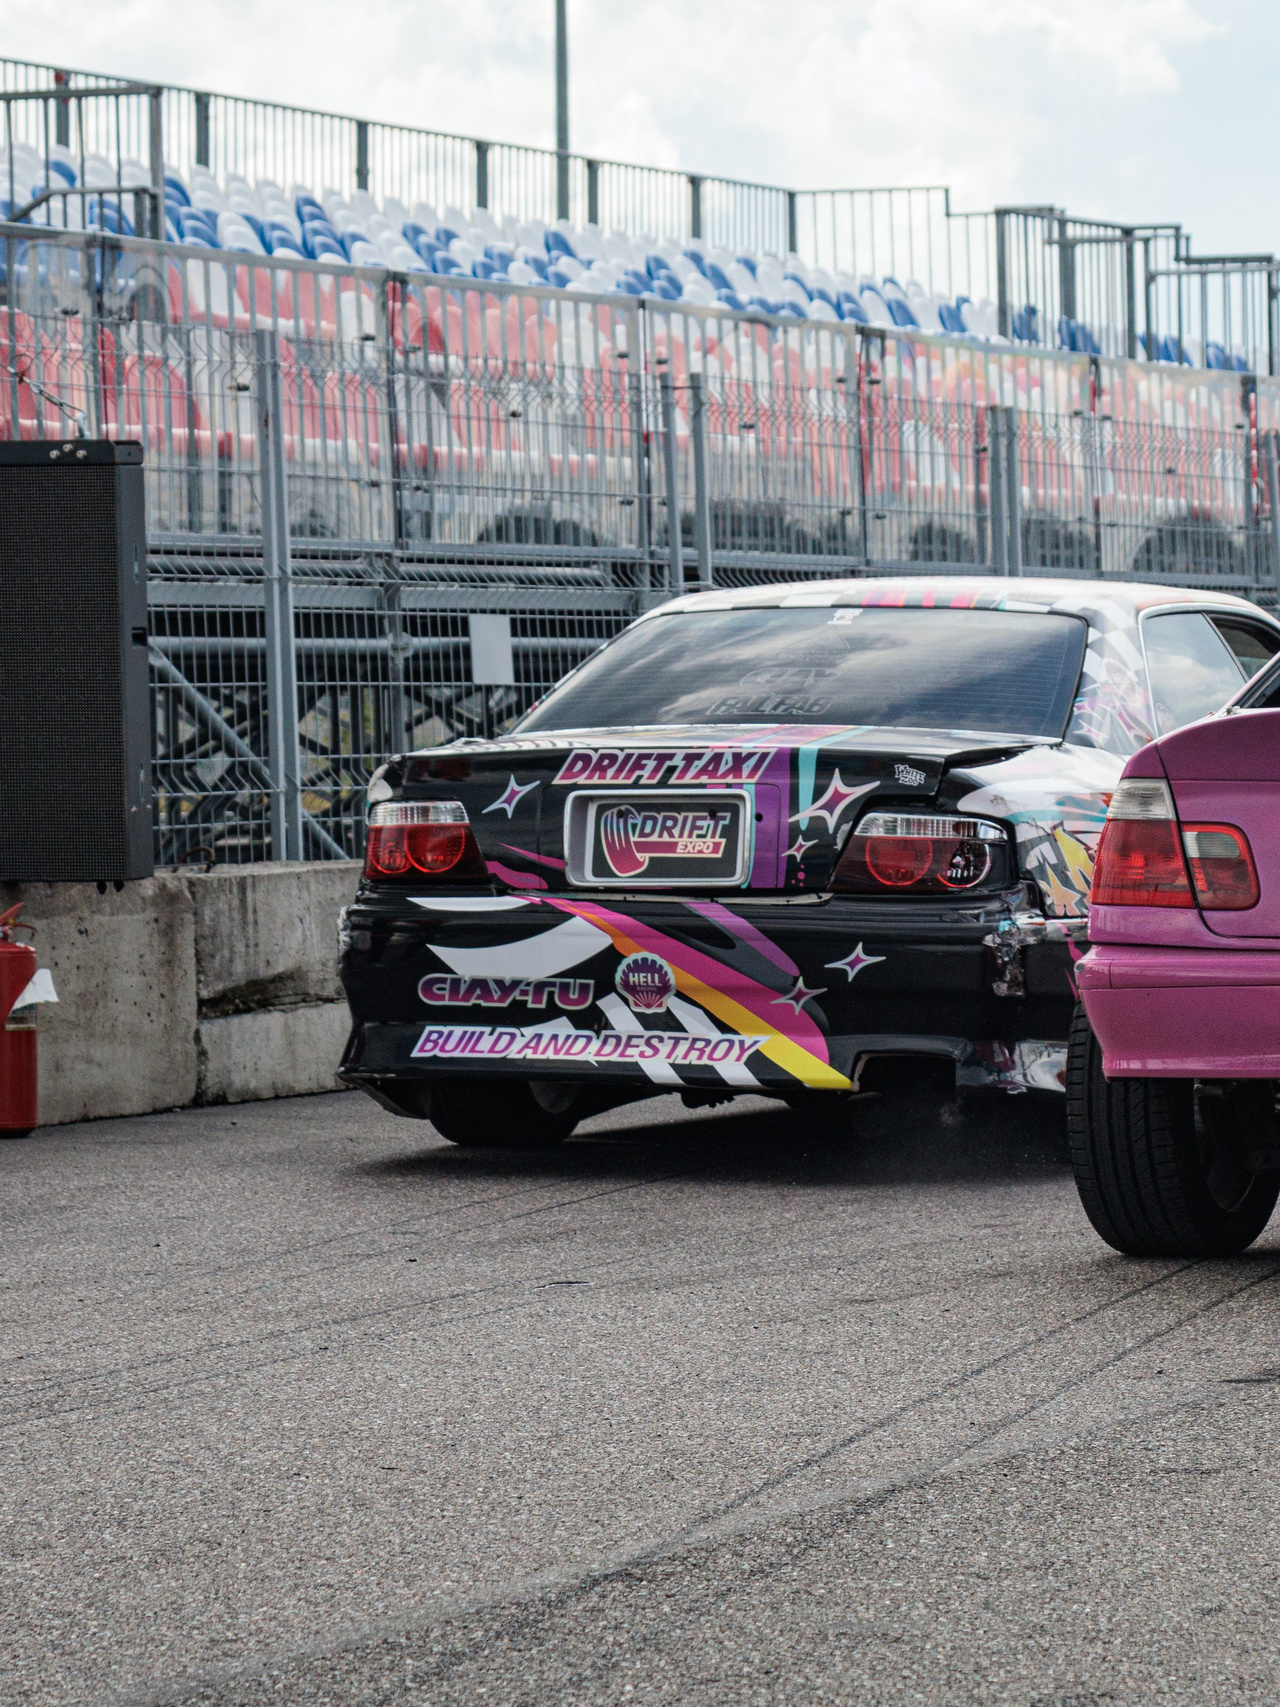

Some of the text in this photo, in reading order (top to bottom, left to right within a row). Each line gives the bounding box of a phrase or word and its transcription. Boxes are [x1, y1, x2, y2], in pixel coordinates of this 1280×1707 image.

[557, 752, 770, 781] DRIFT TAXI
[637, 814, 729, 839] DRIFT
[676, 841, 714, 854] EXPO
[629, 973, 663, 987] HELL
[417, 1029, 765, 1063] BUILD AND DESTROY
